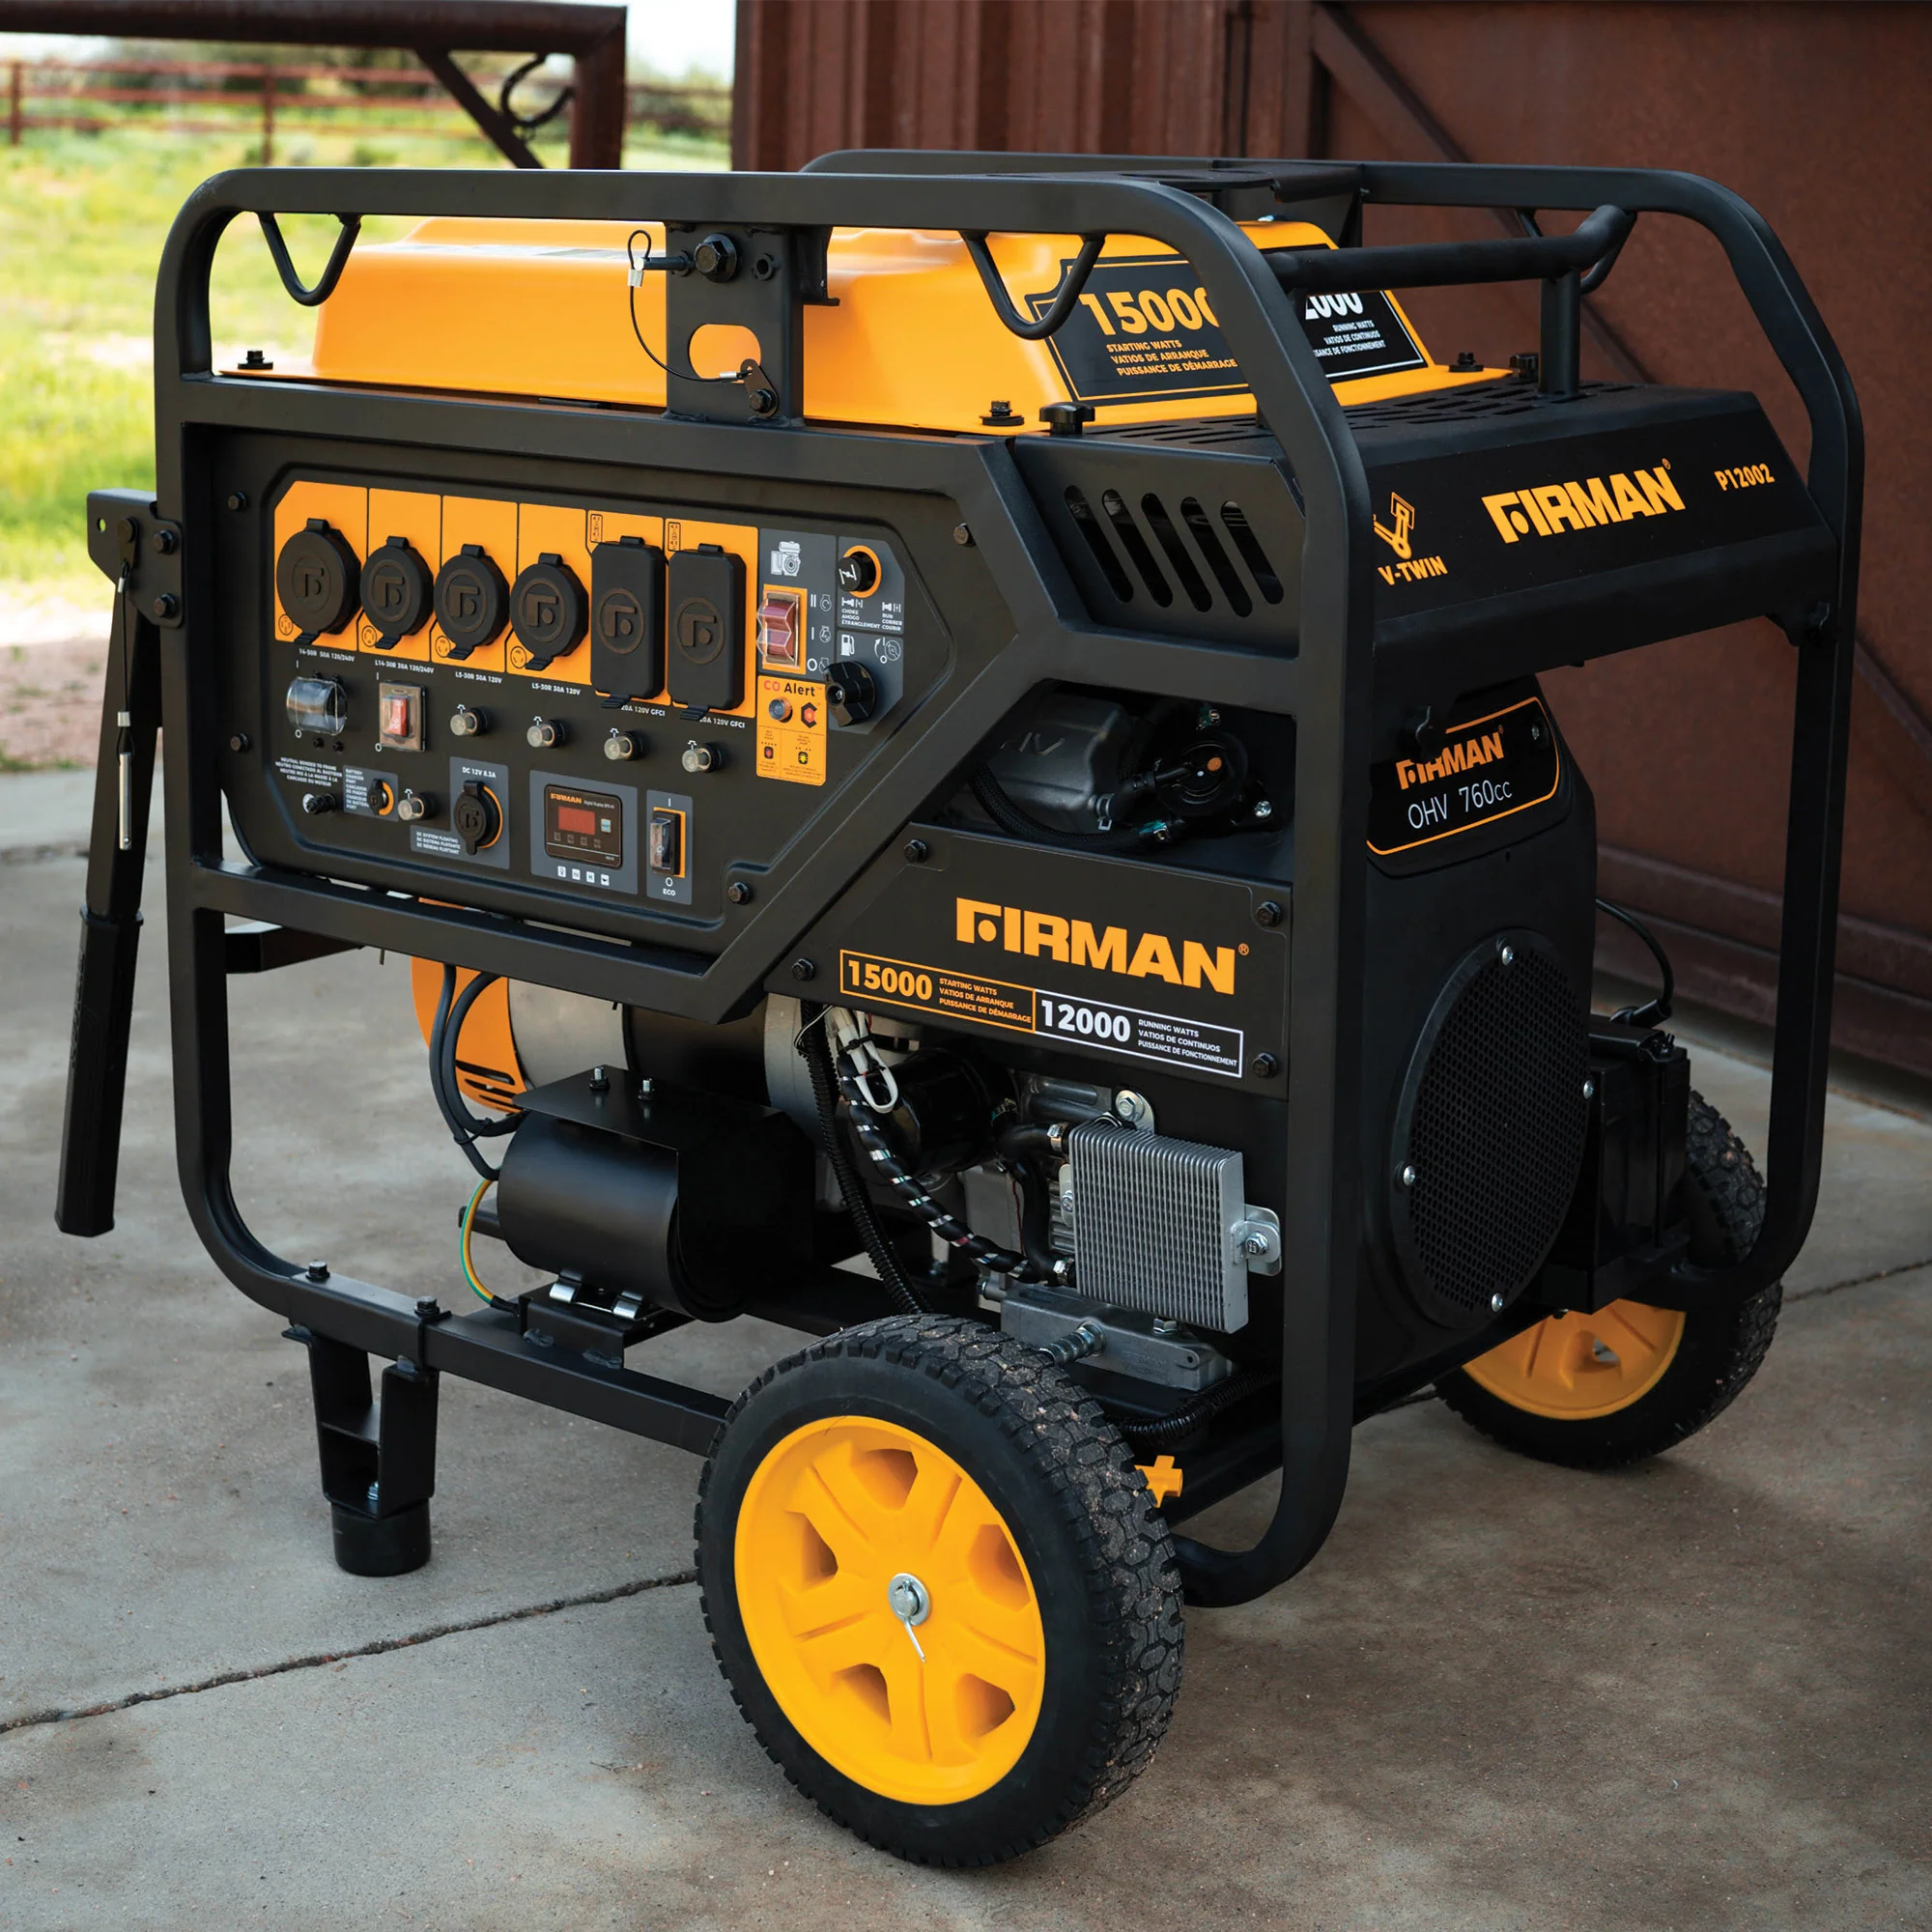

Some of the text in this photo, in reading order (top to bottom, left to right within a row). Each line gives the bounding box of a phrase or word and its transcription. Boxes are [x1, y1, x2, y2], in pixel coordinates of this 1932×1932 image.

[1332, 320, 1375, 332] RUNNING WATTS
[1323, 329, 1380, 345] VATIOS DE CONTINUOS
[1106, 340, 1182, 353] STARTING WATTS
[1332, 346, 1341, 355] DE
[1340, 340, 1386, 354] FONCTIONNEMENT
[1111, 350, 1209, 364] VATIOS DE ARRANQUE
[1117, 358, 1237, 376] PUISSANCE DE DÉMARRAGE
[1715, 463, 1775, 492] P12002
[1481, 465, 1686, 544] FIRMAN
[1378, 555, 1448, 586] V-TWIN
[375, 659, 396, 668] L14-30R
[410, 664, 435, 674] 120/240V
[488, 675, 502, 684] 120V
[763, 680, 815, 696] CO Alert
[566, 687, 582, 696] 120V
[635, 706, 649, 715] 120V
[651, 708, 666, 717] GFCI
[713, 717, 729, 726] 120V
[730, 720, 745, 728] GFCI
[1395, 731, 1504, 790] FIRMAN
[550, 793, 582, 804] FIRMAN
[1407, 780, 1513, 829] OHV 760cc
[663, 888, 676, 896] ECO
[956, 897, 1236, 995] FIRMAN
[848, 959, 933, 1001] 15000
[939, 978, 998, 996] STARTING WATTS
[939, 987, 1014, 1009] VATIOS DE ARRANQUE
[939, 997, 976, 1011] PUISSANCE
[988, 1007, 1032, 1023] DÉMARRAGE
[1041, 999, 1131, 1042] 12000
[1138, 1018, 1199, 1037] RUNNING WATTS
[1138, 1029, 1221, 1053] VATIOS DE CONTINUOS
[1138, 1039, 1237, 1067] PUISSANCE DE FONCTIONNEMENT
